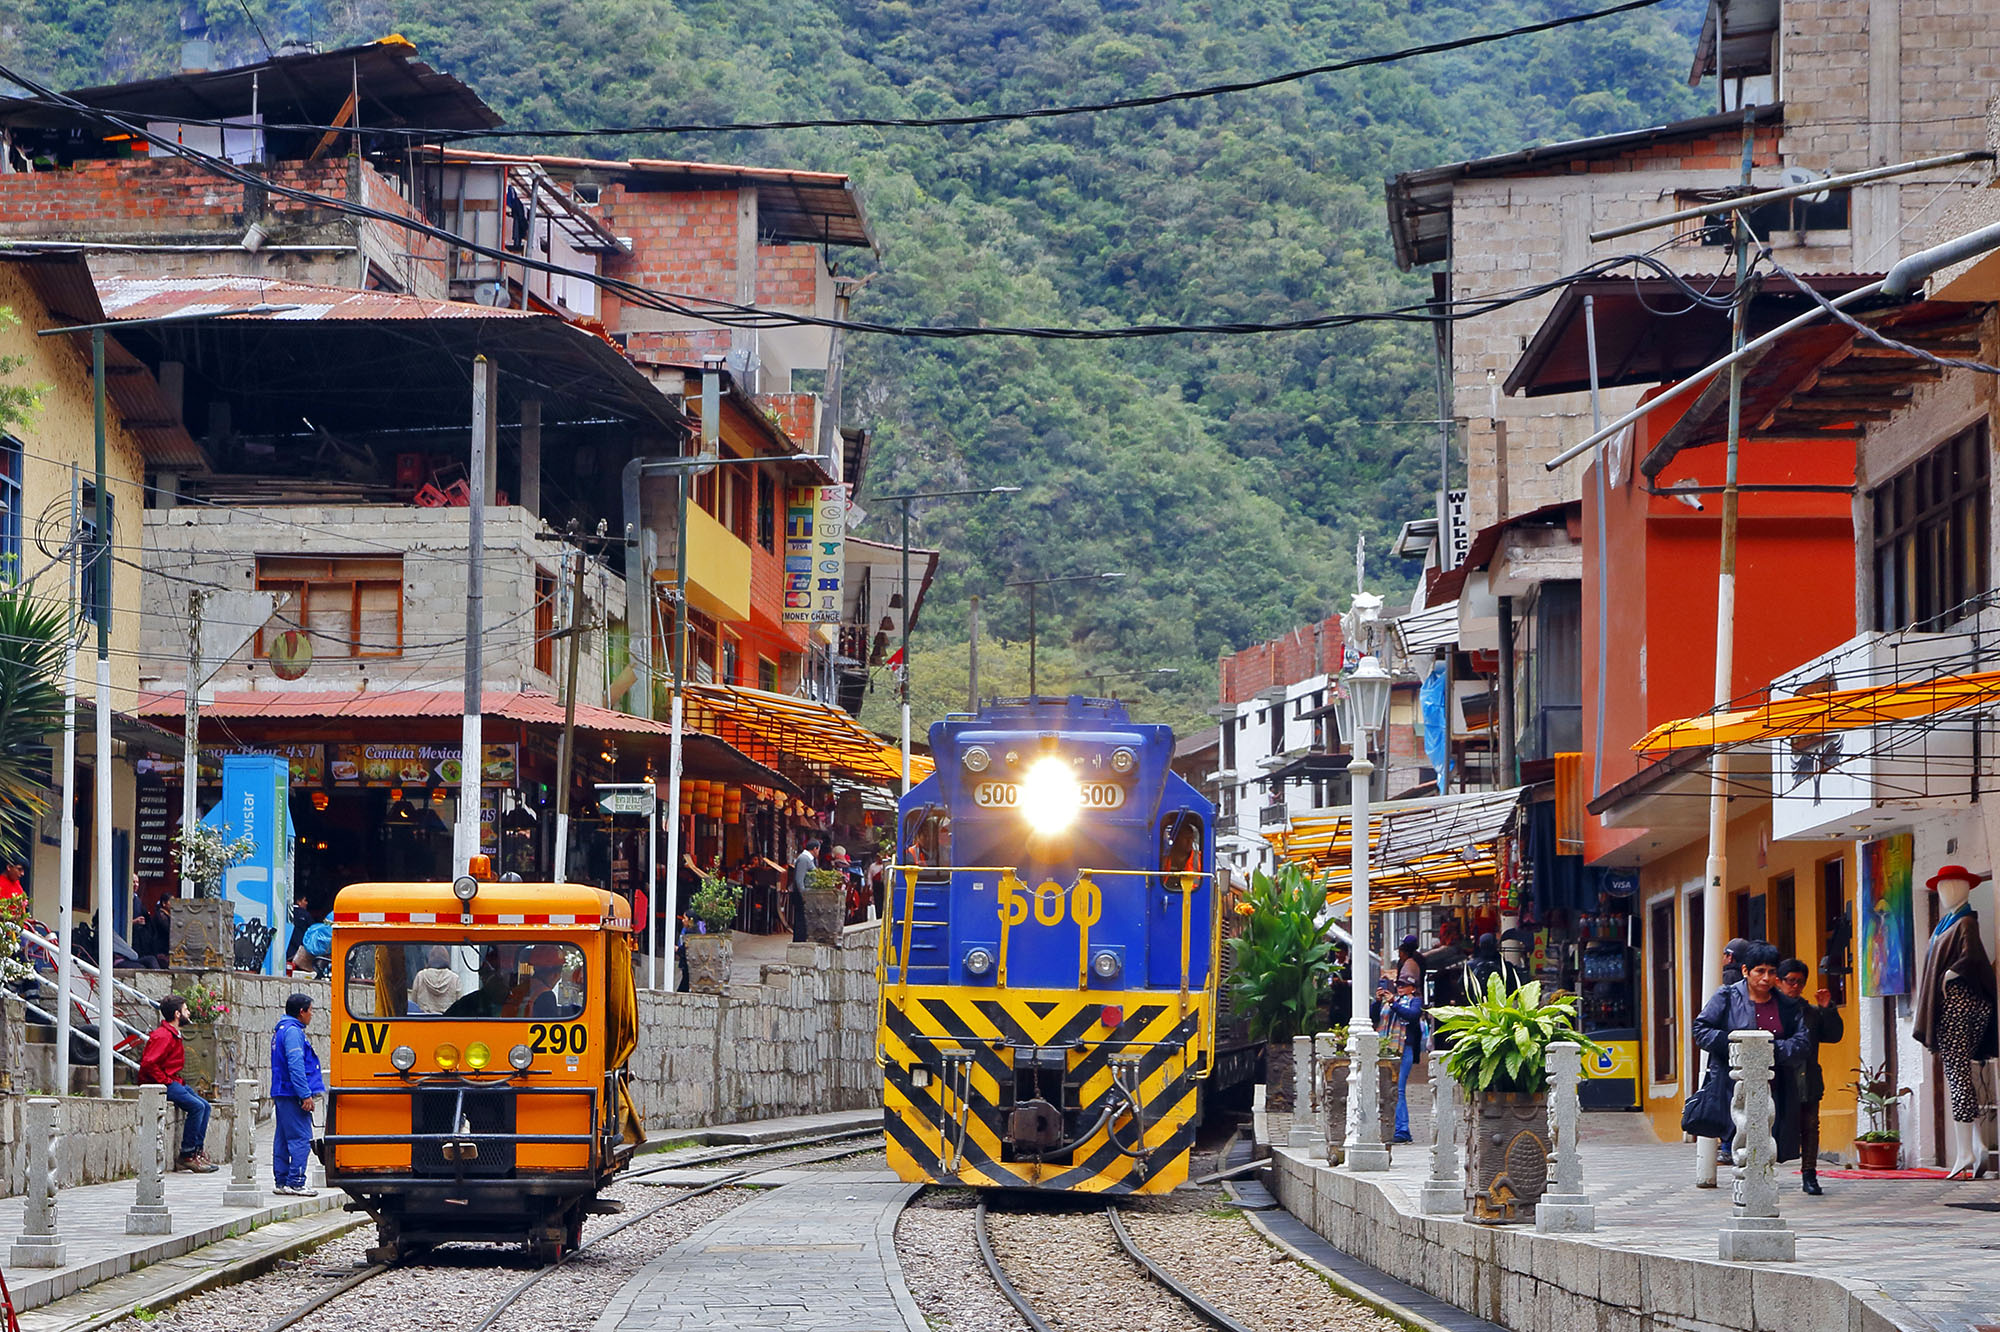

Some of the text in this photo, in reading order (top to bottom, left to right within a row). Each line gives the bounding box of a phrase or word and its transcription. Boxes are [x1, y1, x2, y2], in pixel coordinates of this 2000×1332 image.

[1449, 492, 1468, 568] WILLCA
[791, 543, 808, 551] VISA
[818, 488, 843, 609] KCUYCHI
[784, 612, 840, 621] MONEY CHANGE
[365, 746, 463, 760] Comida Mexica
[980, 784, 1018, 805] 500
[1080, 785, 1117, 806] 500
[243, 791, 255, 845] ovistar
[1612, 881, 1632, 889] VISA
[997, 879, 1103, 927] 500
[342, 1023, 390, 1054] AV
[529, 1023, 588, 1055] 290
